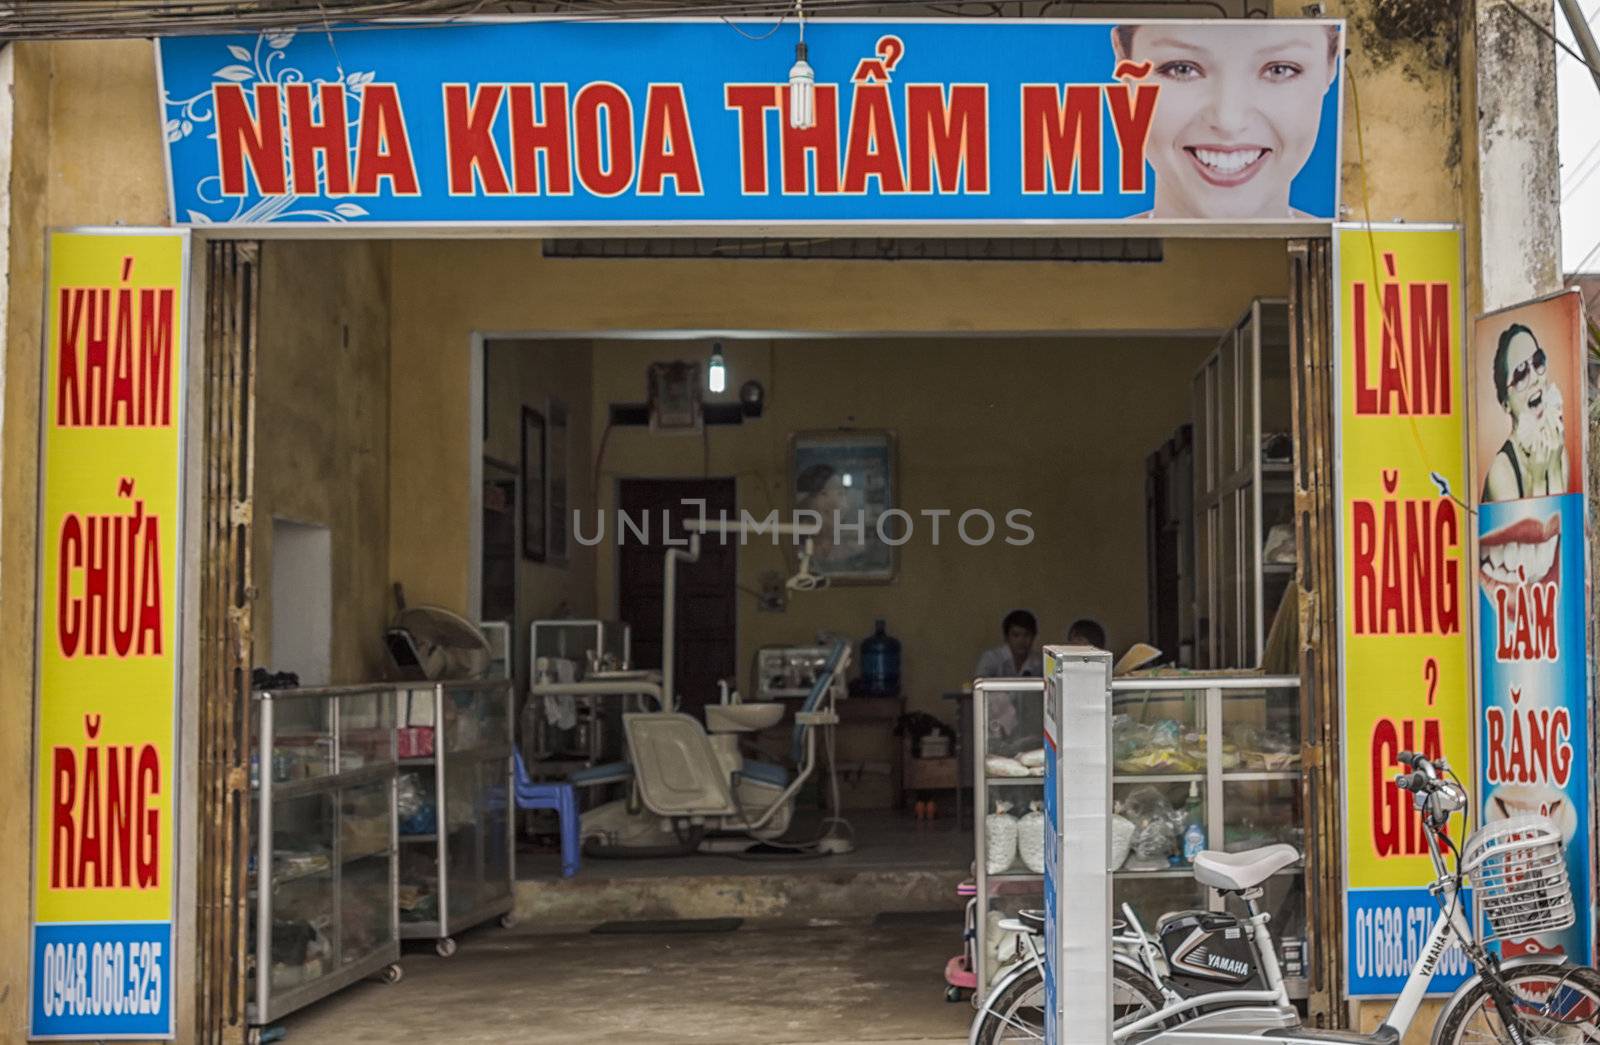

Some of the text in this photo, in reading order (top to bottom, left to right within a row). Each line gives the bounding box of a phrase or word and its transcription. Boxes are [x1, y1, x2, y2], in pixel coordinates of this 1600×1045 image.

[213, 36, 1161, 197] NHA KHOA THẨM MỸ
[56, 256, 175, 428] KHÁM
[1353, 253, 1452, 416] LÀM
[58, 477, 163, 658] CHỮA
[1352, 469, 1460, 636] RĂNG
[1495, 564, 1560, 662] LÀM
[50, 714, 160, 890] RĂNG
[1486, 687, 1573, 787] RĂNG
[43, 941, 162, 1017] 0948.060.525
[1208, 954, 1249, 976] YAMAHA
[1420, 936, 1447, 977] YAMAHA
